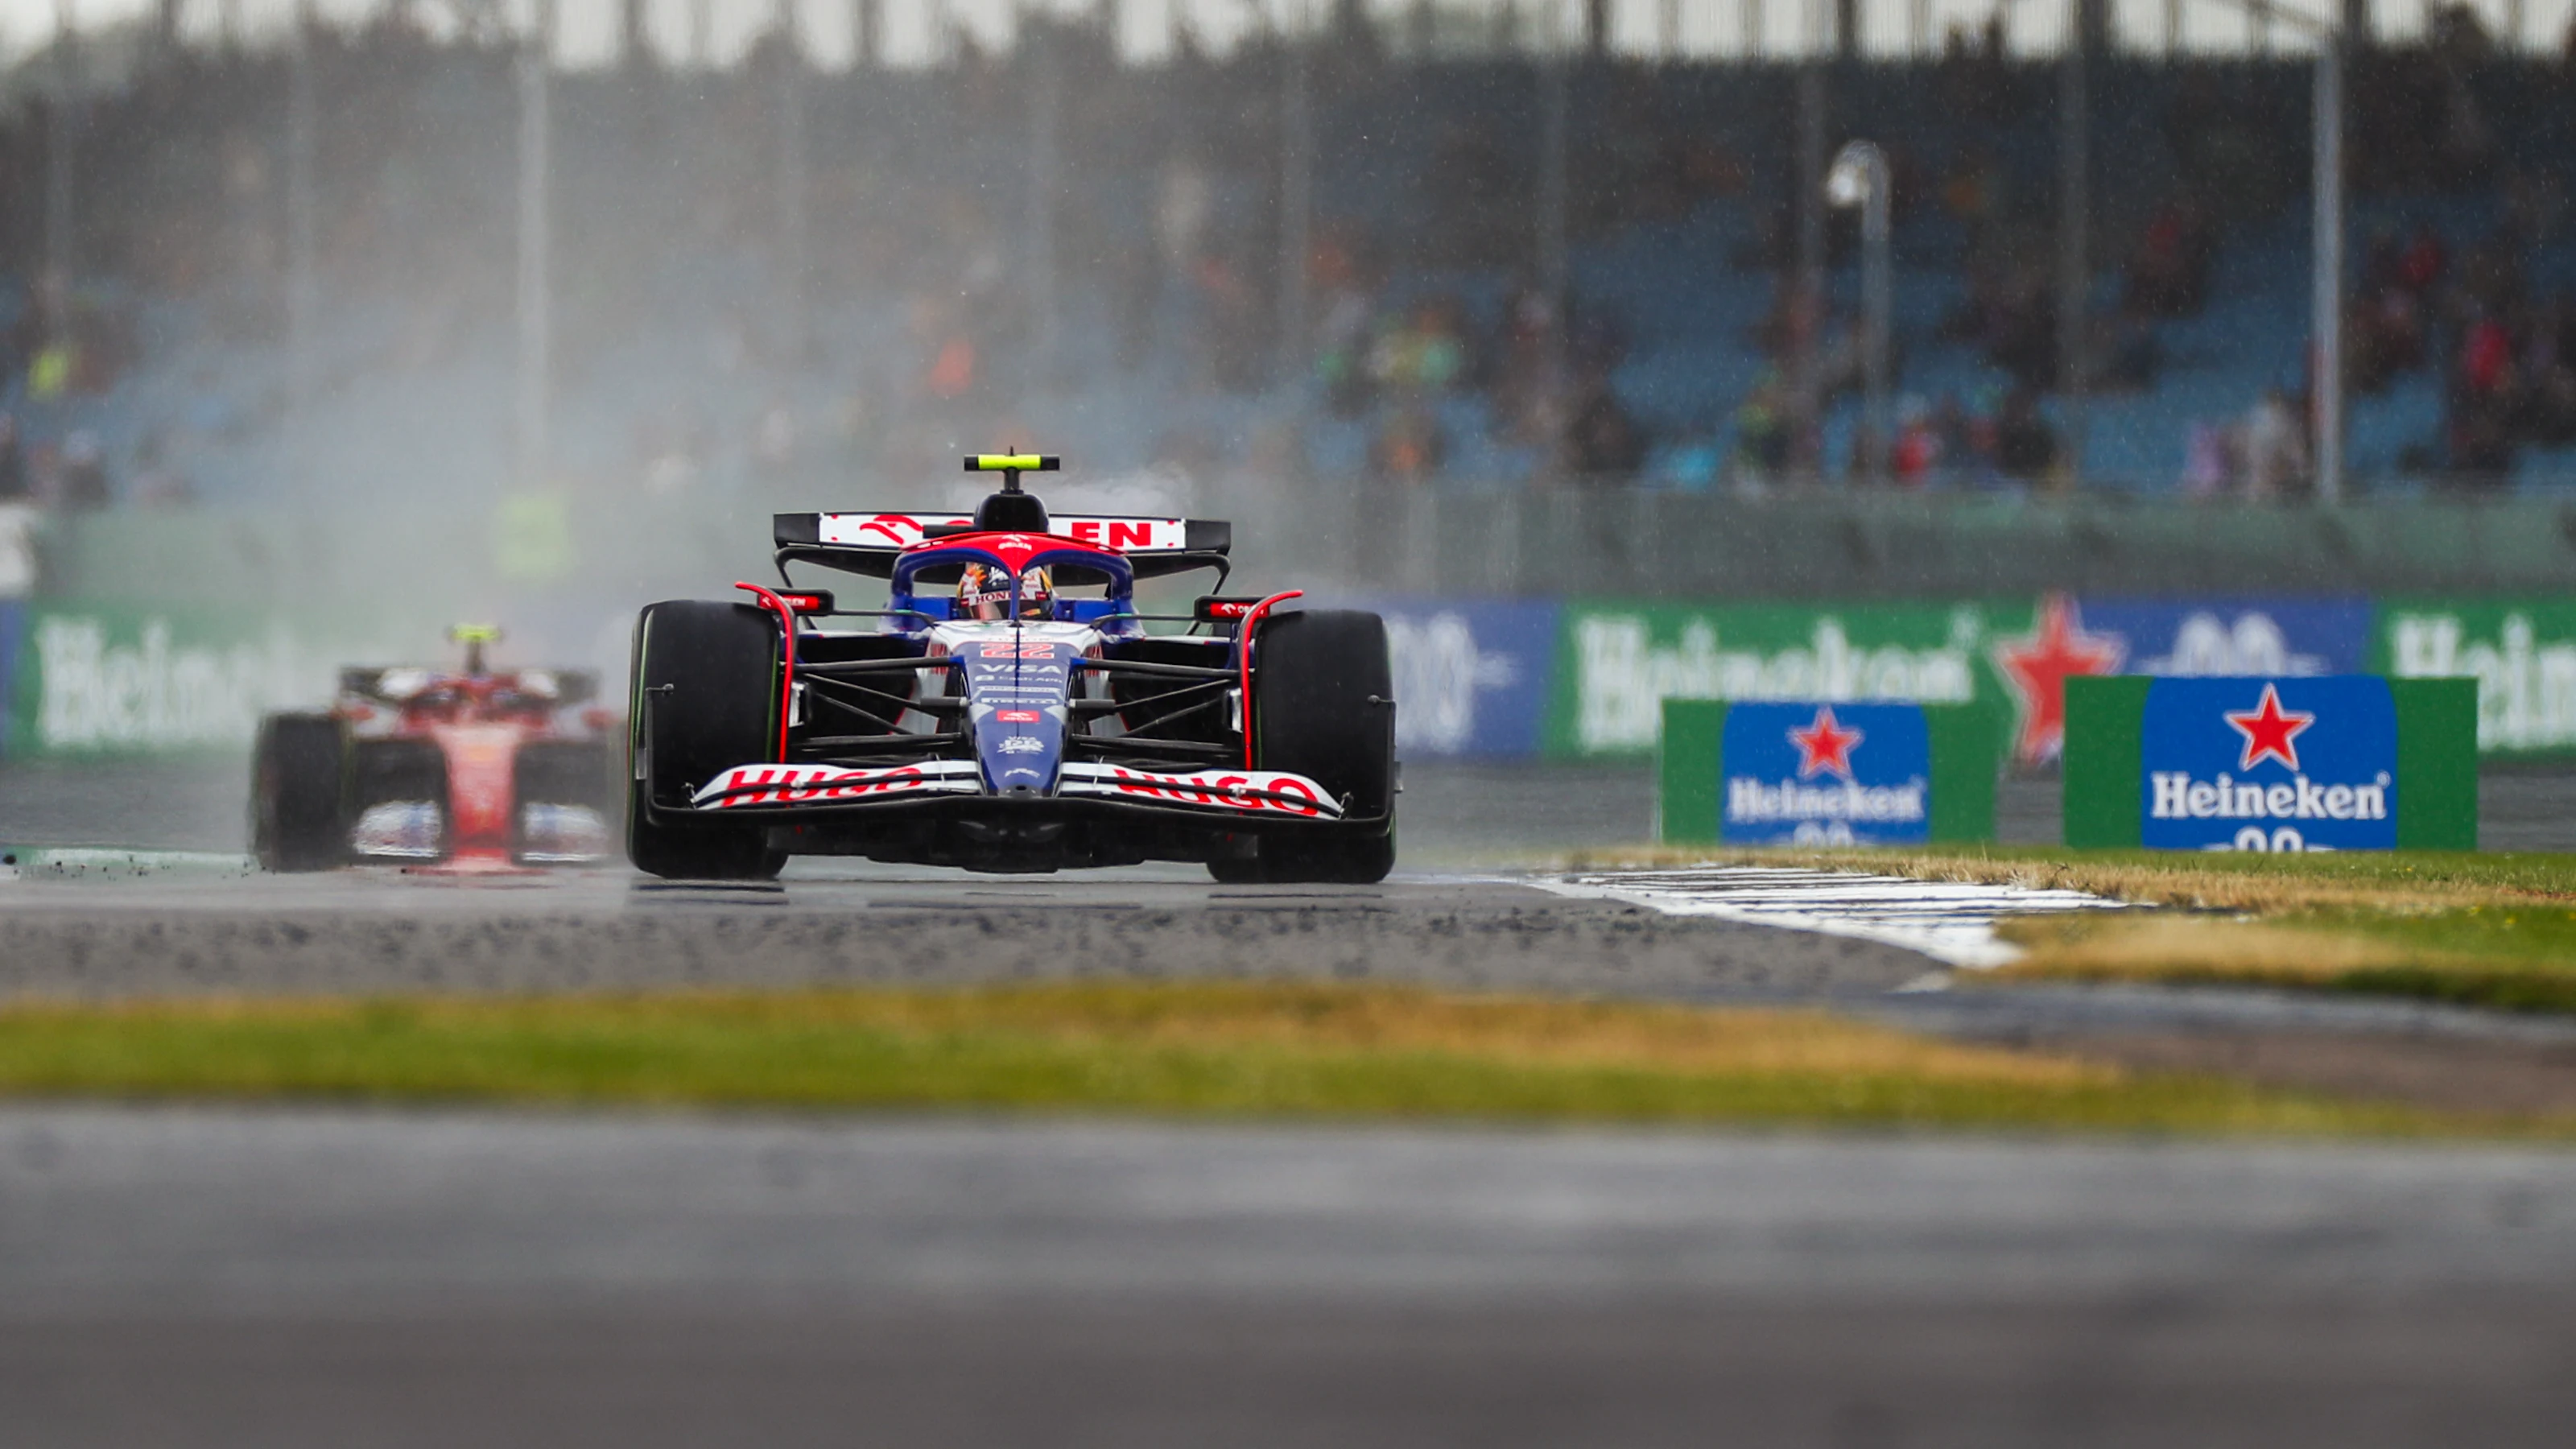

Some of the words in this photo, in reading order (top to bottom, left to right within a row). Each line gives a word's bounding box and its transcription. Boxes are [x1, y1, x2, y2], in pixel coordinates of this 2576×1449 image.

[975, 590, 1029, 605] HONA
[980, 643, 1055, 659] 22
[977, 663, 1062, 675] VISA
[721, 767, 923, 807] HUGO
[1113, 769, 1320, 817] HUGO
